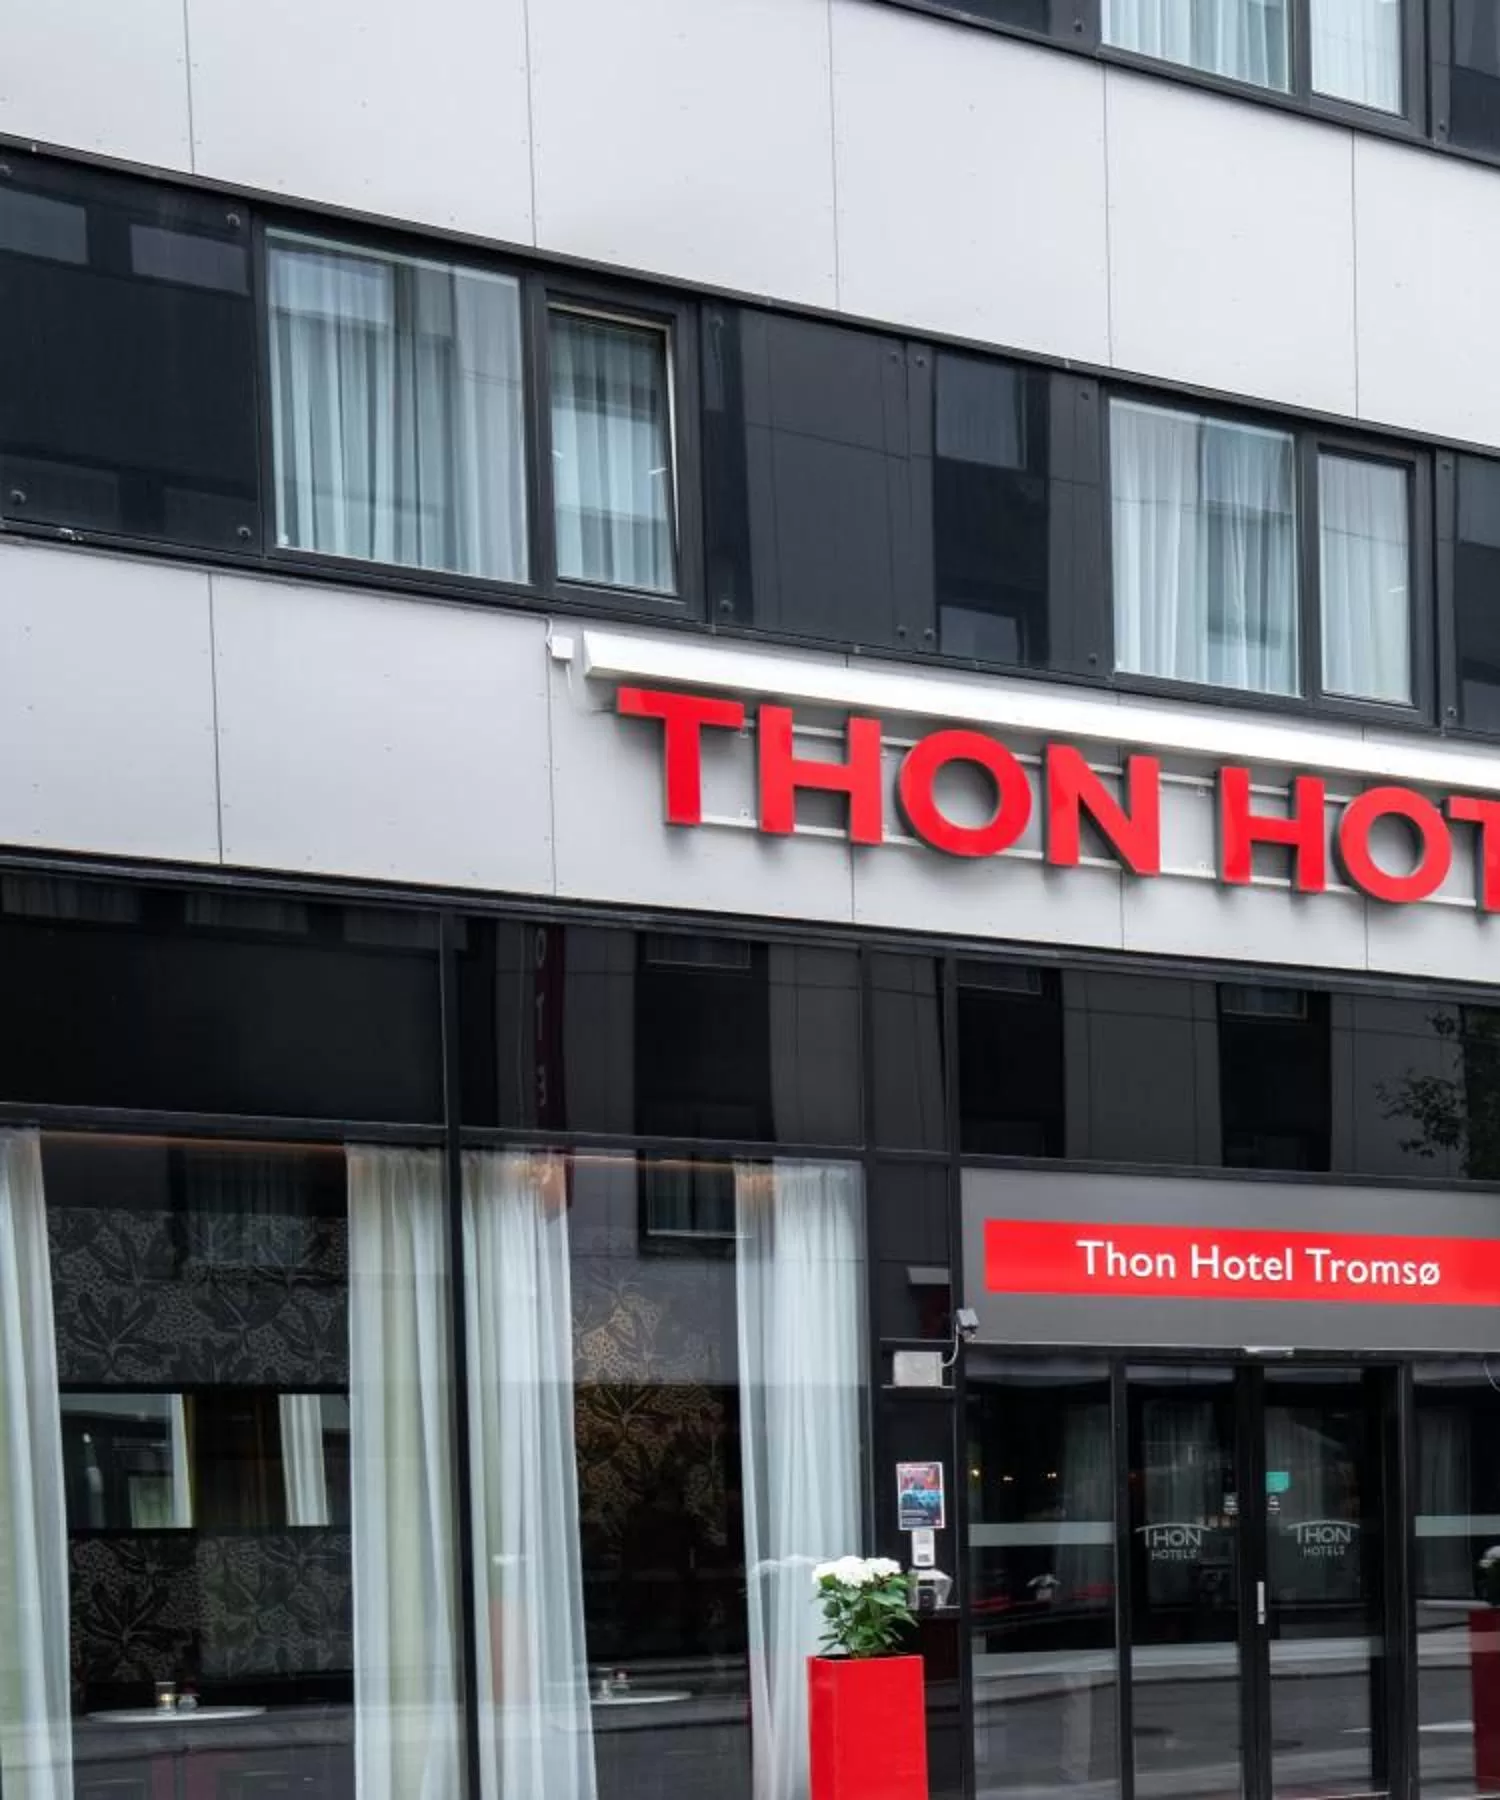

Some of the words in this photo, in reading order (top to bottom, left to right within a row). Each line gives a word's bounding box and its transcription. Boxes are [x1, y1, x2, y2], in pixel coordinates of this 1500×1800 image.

[616, 686, 1161, 877] THON
[1075, 1239, 1177, 1280] Thon
[1190, 1243, 1294, 1283] Hotel
[1305, 1247, 1442, 1287] Tromsø
[1135, 1523, 1211, 1548] THON
[1287, 1520, 1361, 1544] THON
[1151, 1549, 1197, 1561] HOTELS
[1303, 1545, 1345, 1557] HOTELS
